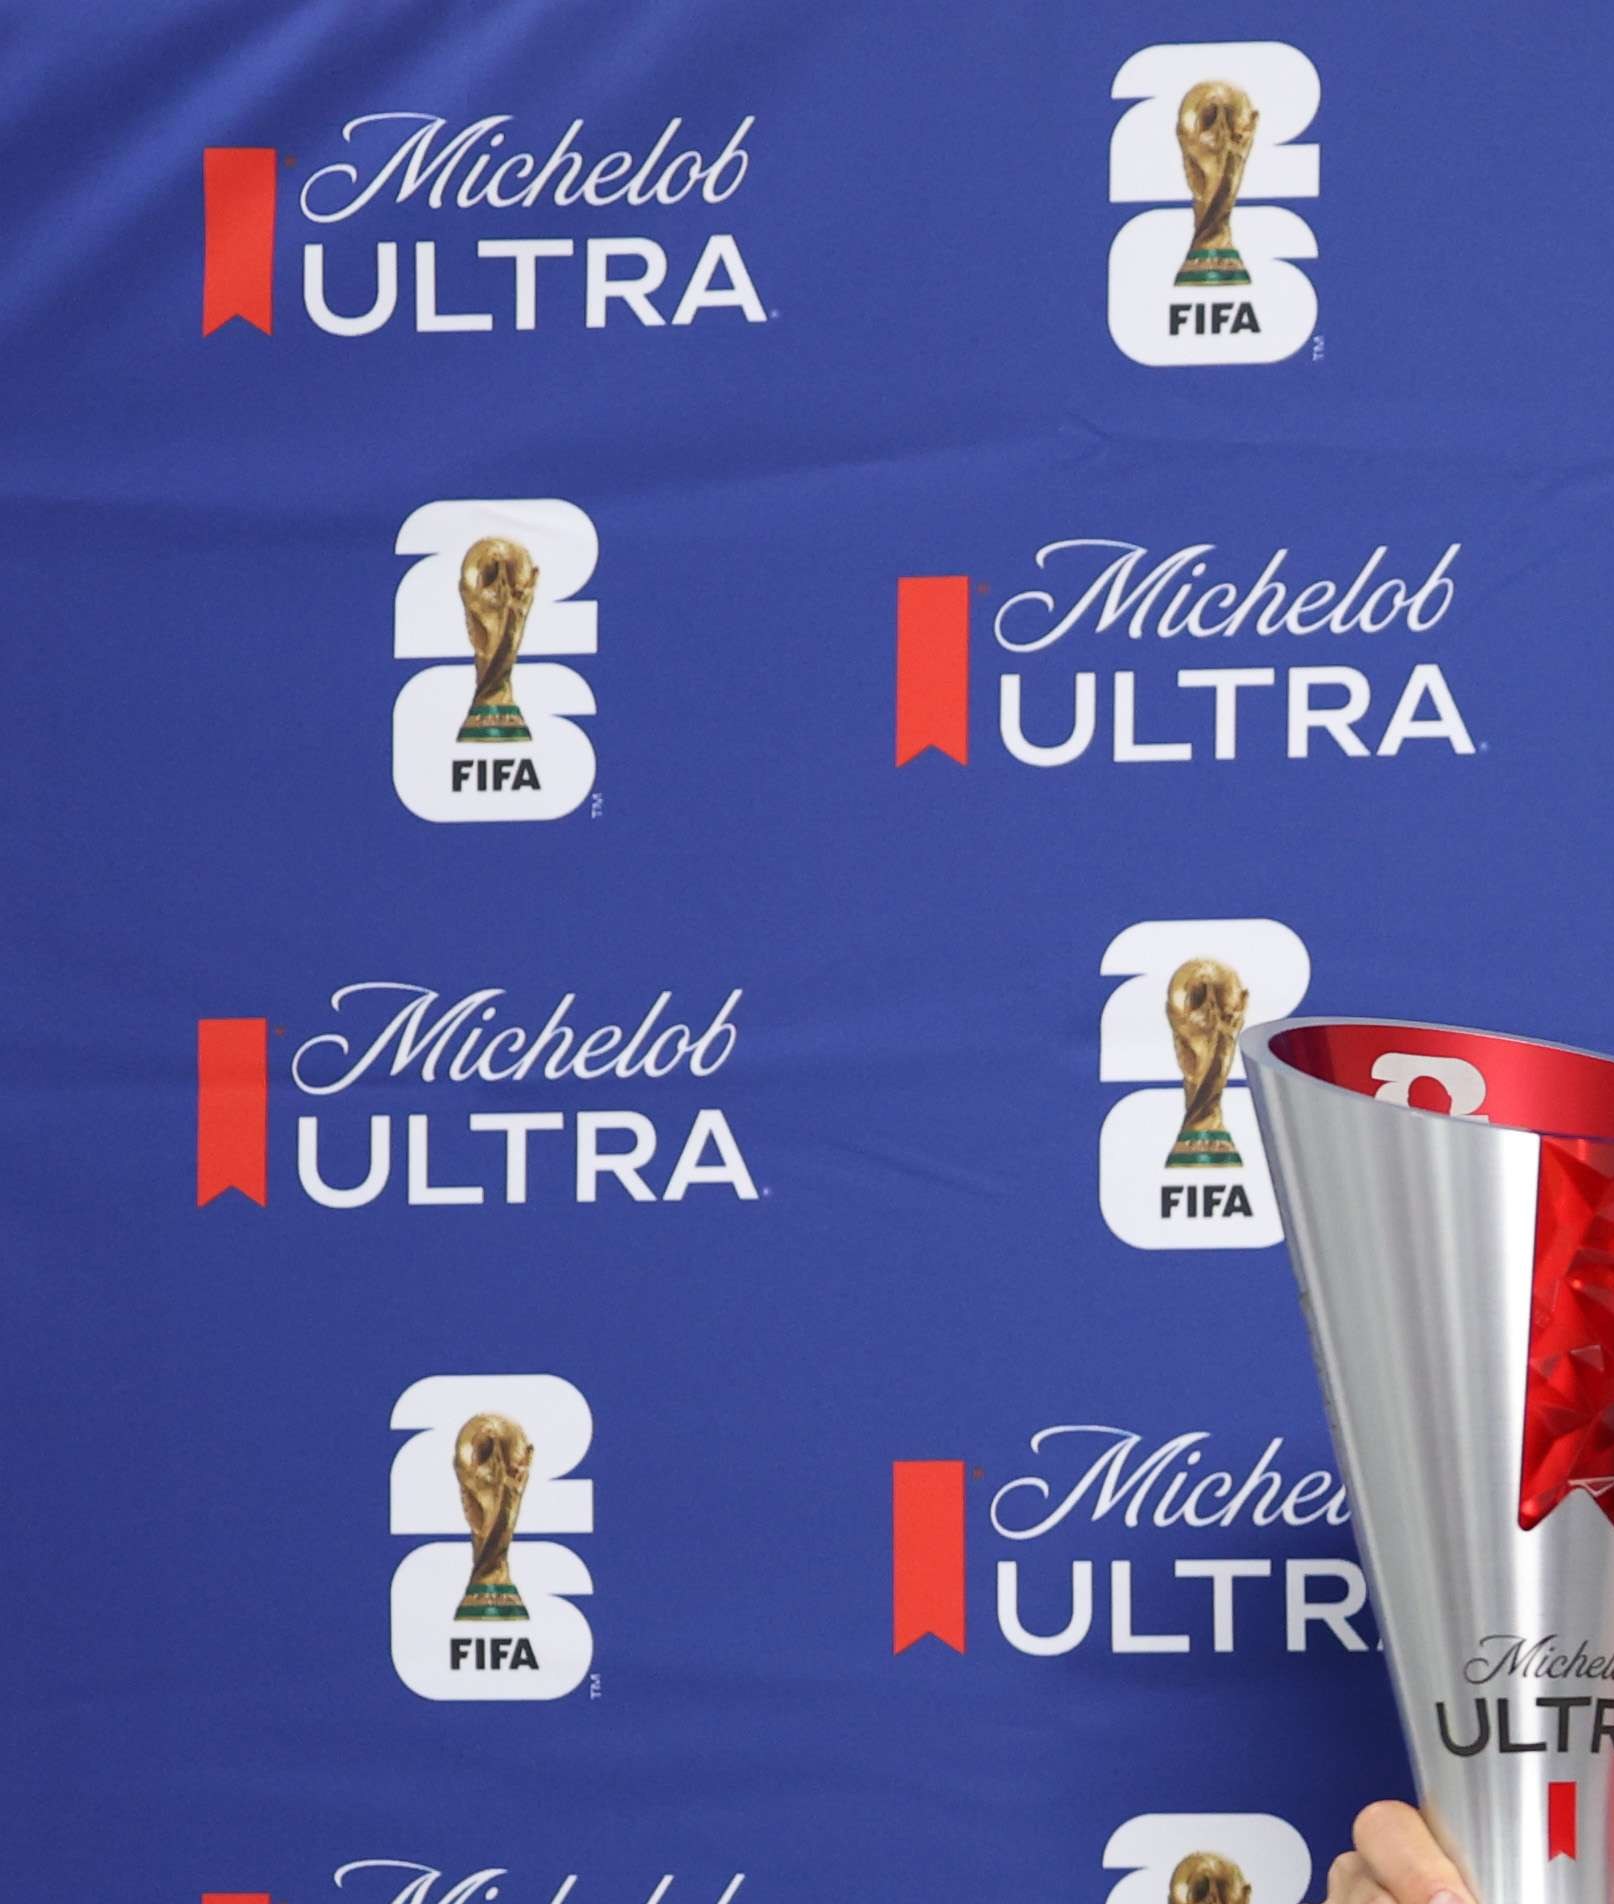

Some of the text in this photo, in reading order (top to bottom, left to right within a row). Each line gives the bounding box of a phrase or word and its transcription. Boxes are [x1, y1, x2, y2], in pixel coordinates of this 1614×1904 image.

[299, 112, 755, 224] Michelob
[303, 234, 768, 337] ULTRA
[1169, 302, 1261, 336] FIFA
[994, 538, 1462, 653] Michelob
[999, 663, 1477, 768] ULTRA
[452, 758, 541, 792] FIFA
[291, 981, 743, 1096] Michelob
[297, 1108, 759, 1209] ULTRA
[1160, 1184, 1254, 1219] FIFA
[990, 1424, 1351, 1540] Miche
[450, 1637, 540, 1670] FIFA
[997, 1558, 1387, 1657] ULTR
